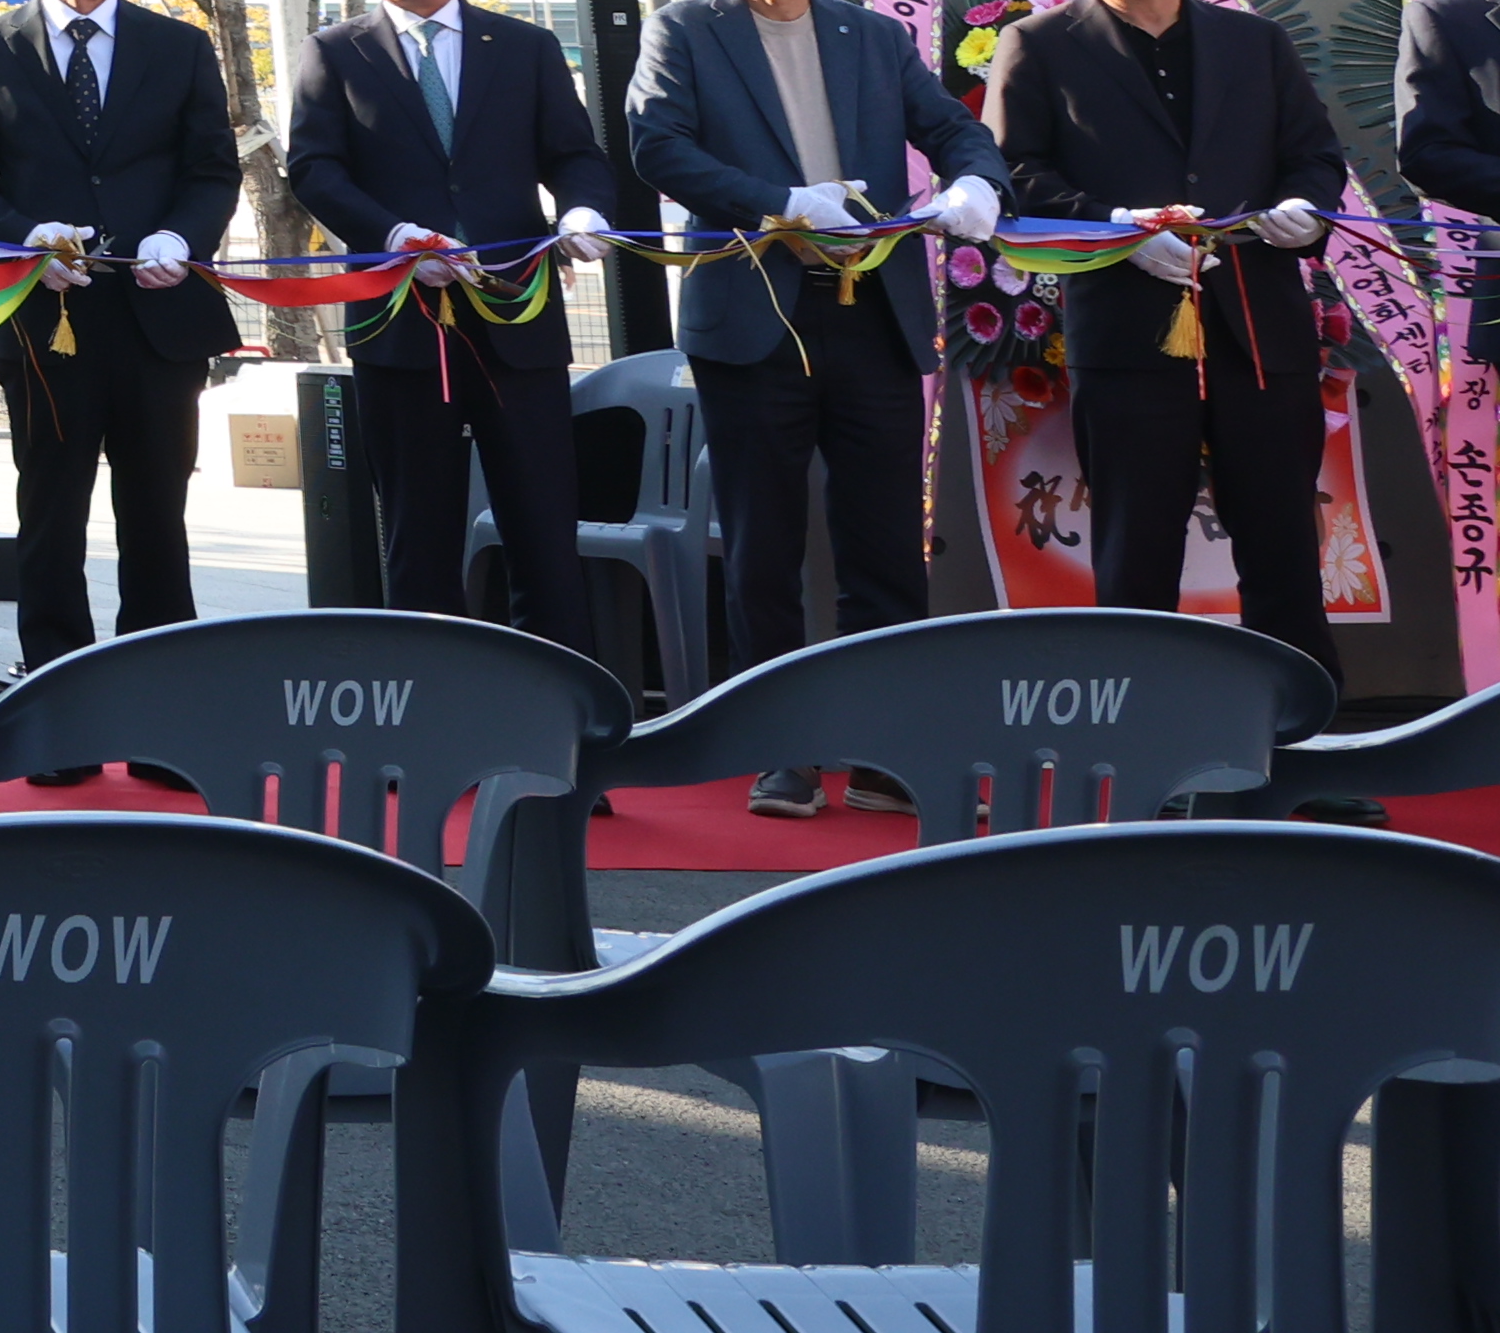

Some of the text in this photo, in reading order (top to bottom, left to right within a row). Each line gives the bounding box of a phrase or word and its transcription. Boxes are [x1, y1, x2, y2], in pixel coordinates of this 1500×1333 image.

[1447, 439, 1494, 595] 손종규
[282, 678, 414, 728] WOW
[1000, 676, 1132, 727] WOW
[1118, 922, 1315, 995] WOW
